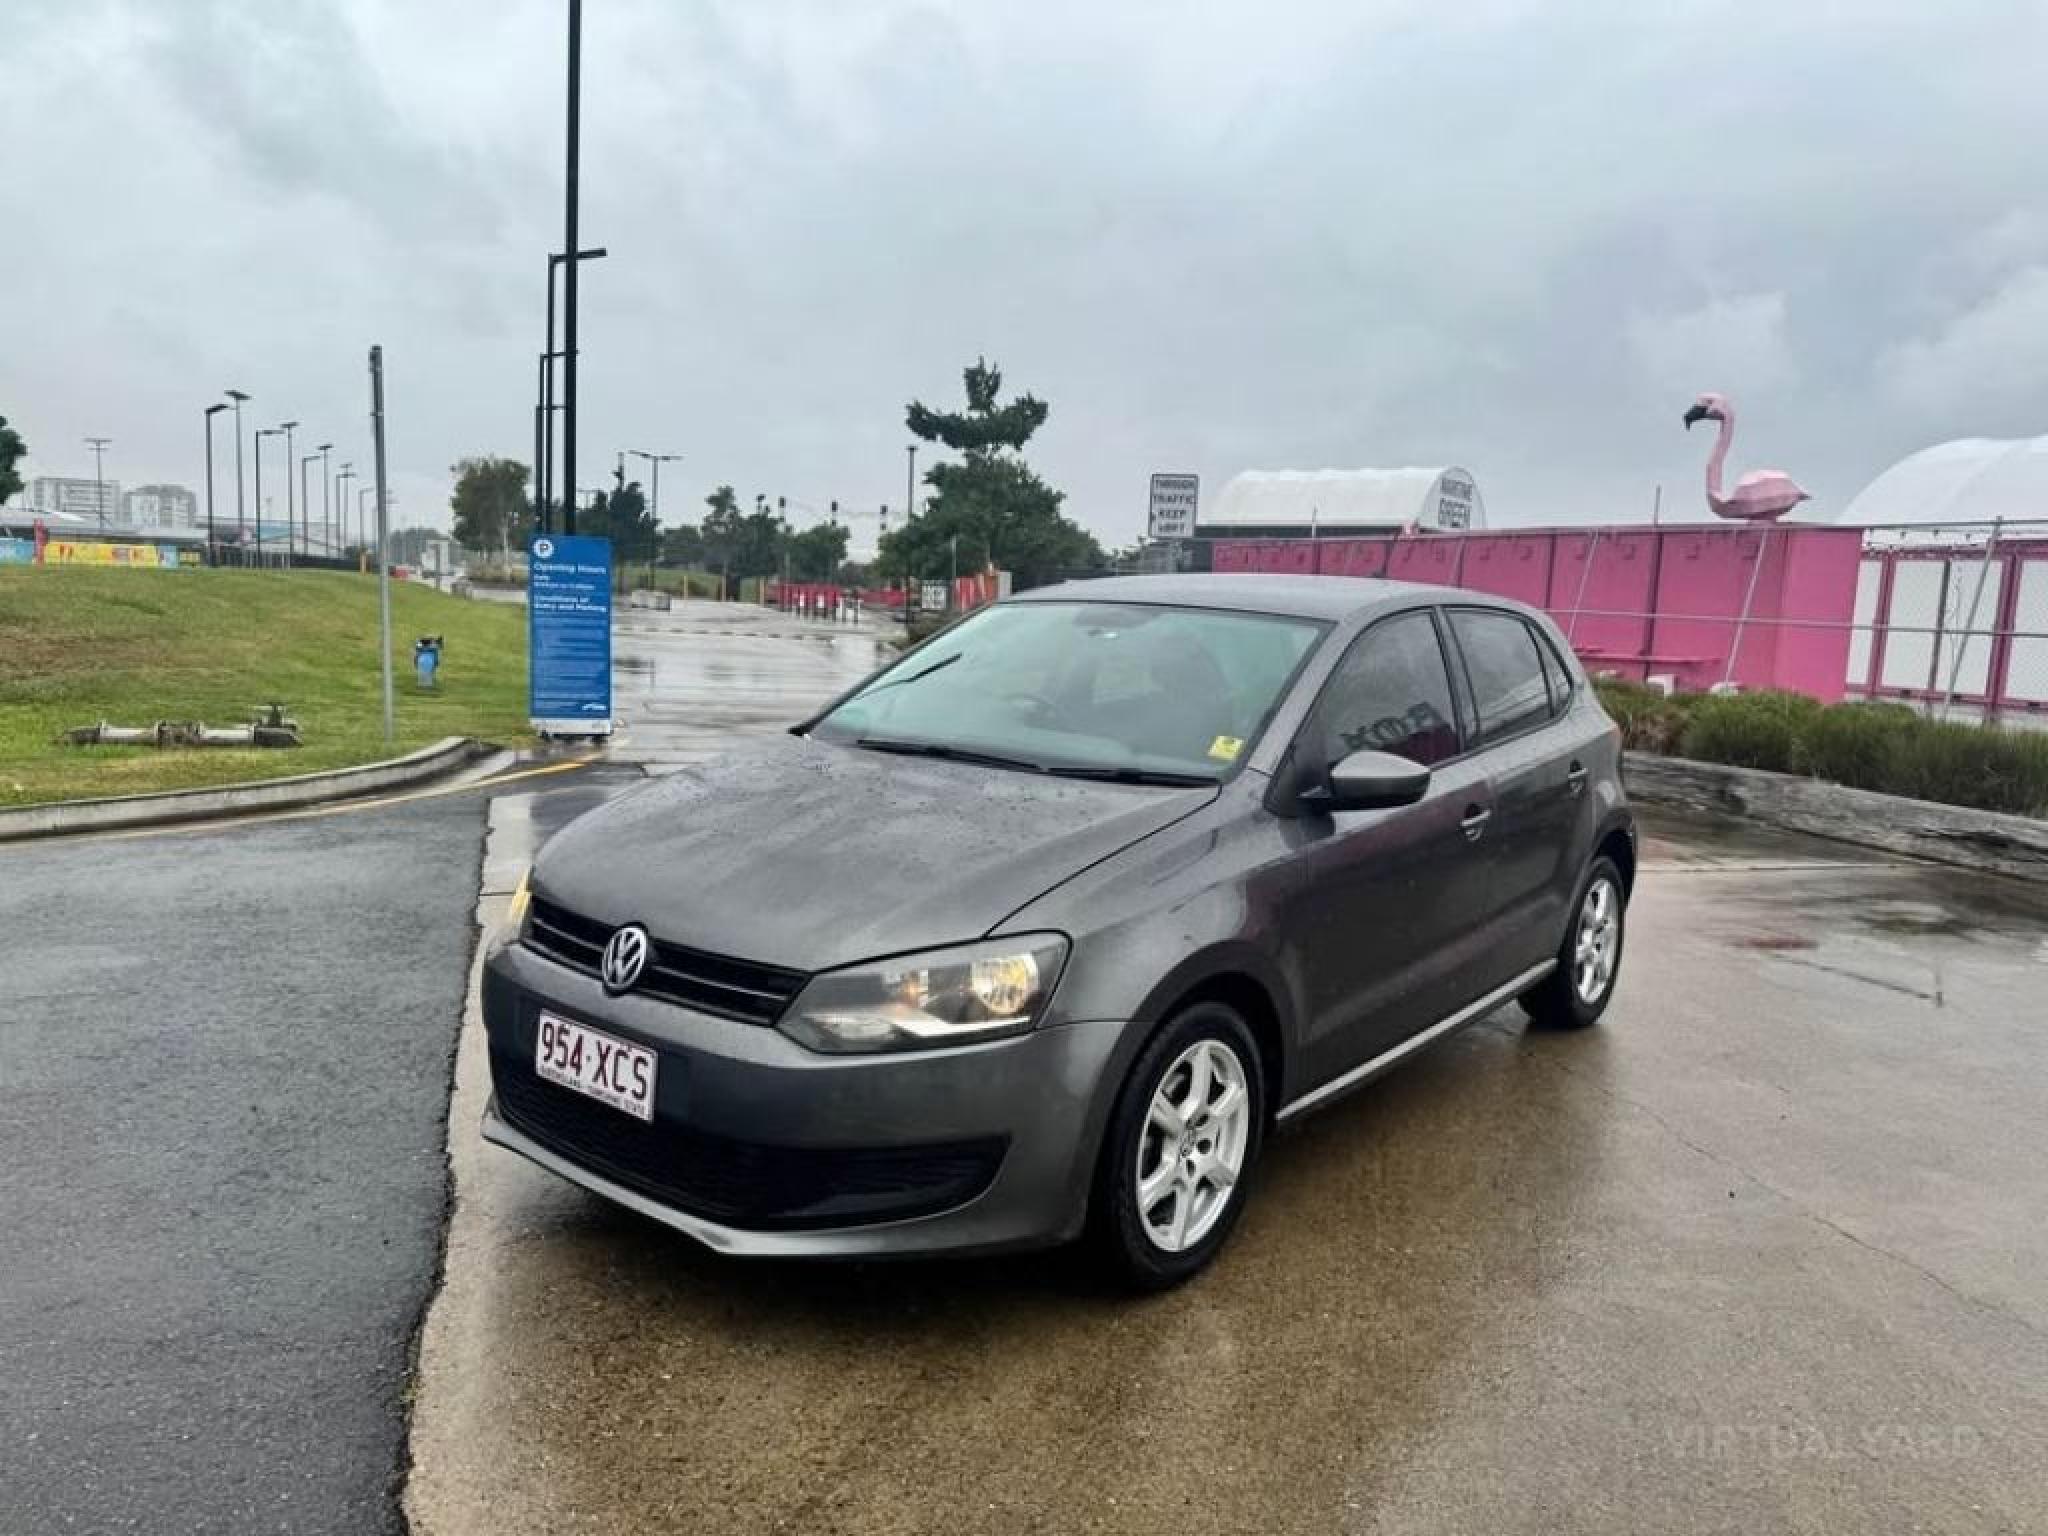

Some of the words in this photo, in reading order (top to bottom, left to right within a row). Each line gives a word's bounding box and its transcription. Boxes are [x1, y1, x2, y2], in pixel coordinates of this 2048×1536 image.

[1155, 480, 1194, 489] THROUGH
[1153, 495, 1194, 504] TRAFFIC
[1159, 510, 1186, 519] KEEP
[533, 562, 575, 574] Opening
